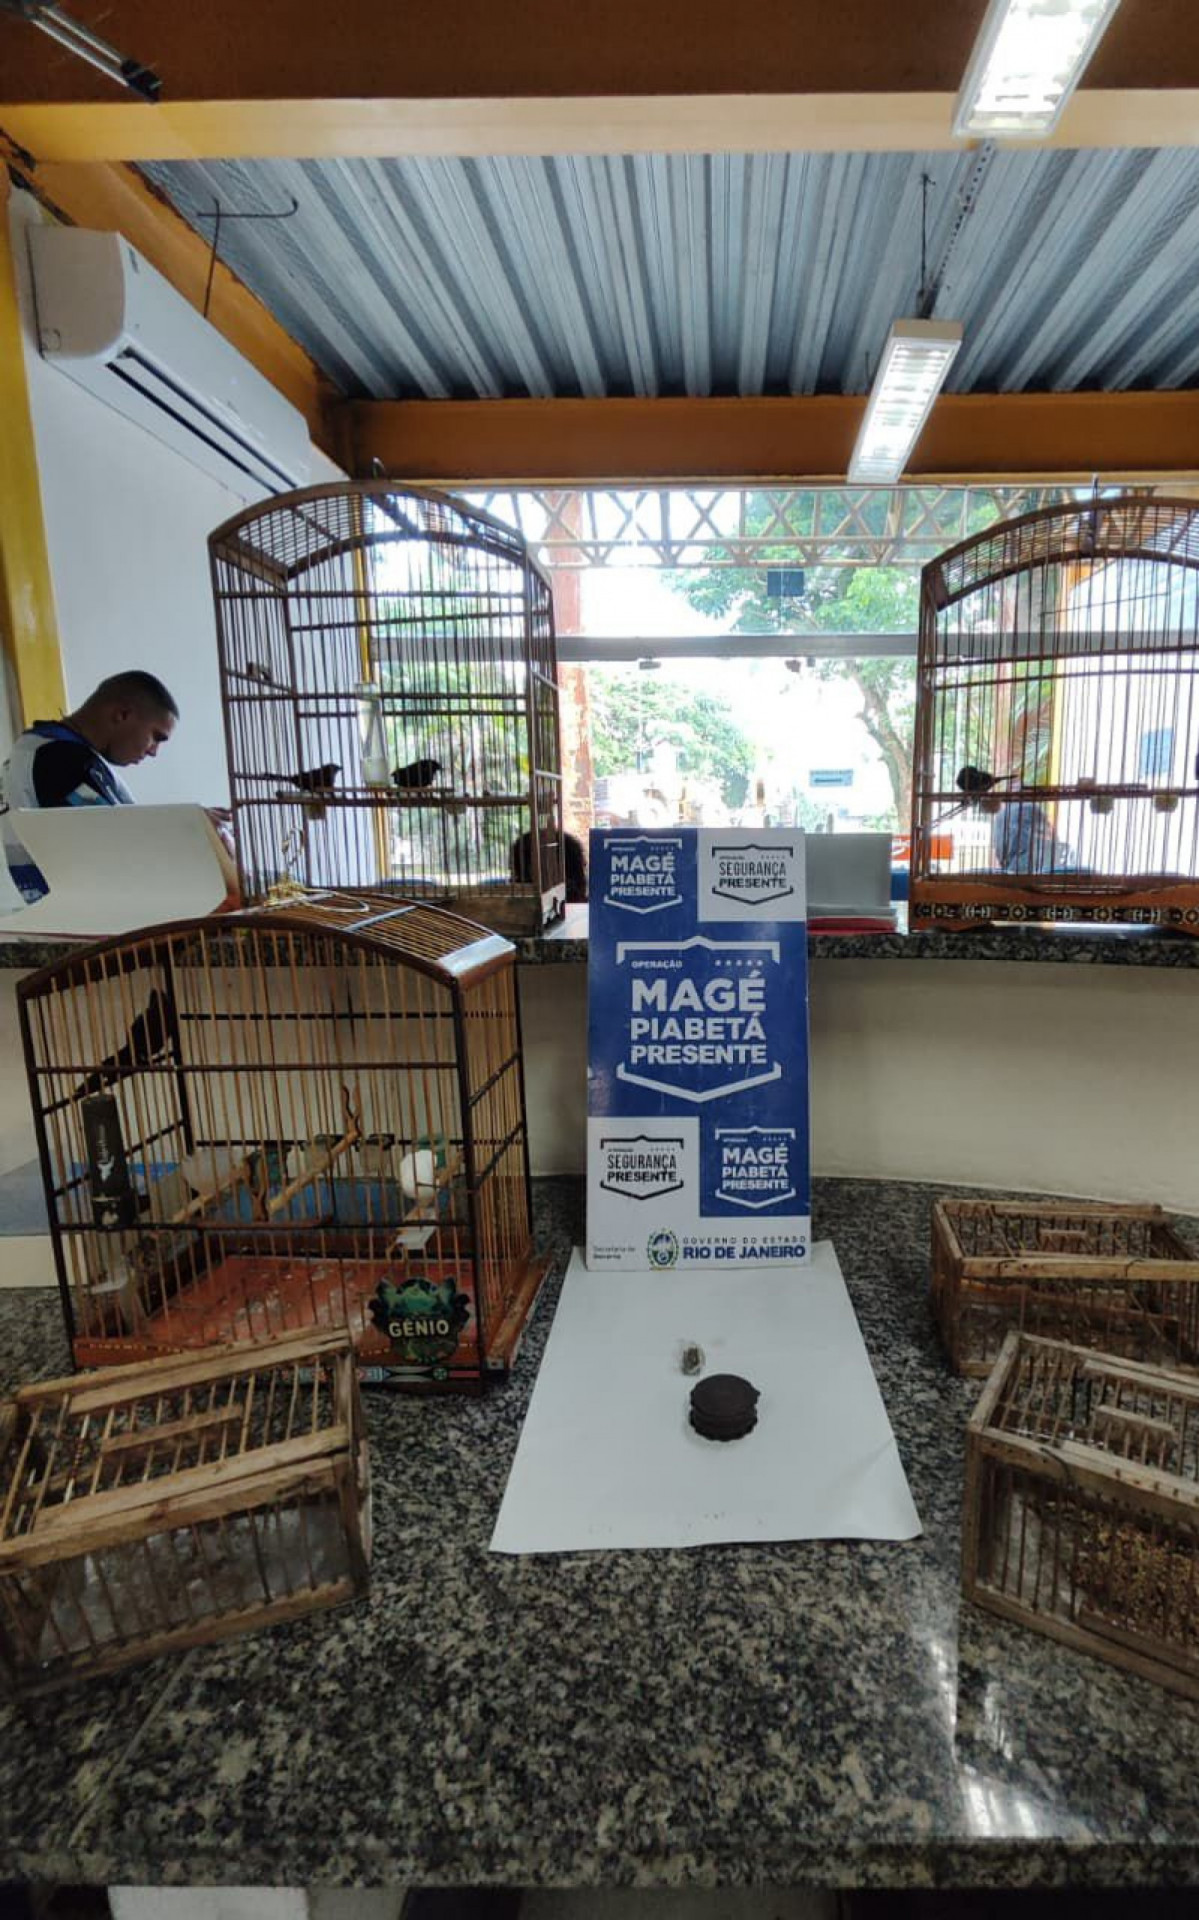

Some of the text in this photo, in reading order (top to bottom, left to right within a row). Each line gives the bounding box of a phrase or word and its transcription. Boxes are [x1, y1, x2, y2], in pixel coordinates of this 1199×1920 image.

[611, 852, 675, 872] MAGÉ
[719, 861, 786, 878] SEGURANÇA
[611, 871, 675, 886] PIABETÁ
[719, 878, 786, 888] PRESENTE
[611, 886, 675, 896] PRESENTE
[631, 969, 766, 1012] MAGÉ
[630, 1012, 767, 1041] PIABETÁ
[631, 1044, 767, 1064] PRESENTE
[722, 1143, 789, 1164] MAGÉ
[607, 1154, 676, 1172] SEGURANÇA
[607, 1171, 676, 1182] PRESENTE
[722, 1164, 788, 1178] PIABETÁ
[722, 1179, 789, 1190] PRESENTE
[683, 1237, 737, 1245] GOVERNO
[683, 1245, 806, 1259] RIO DE JANEIRO
